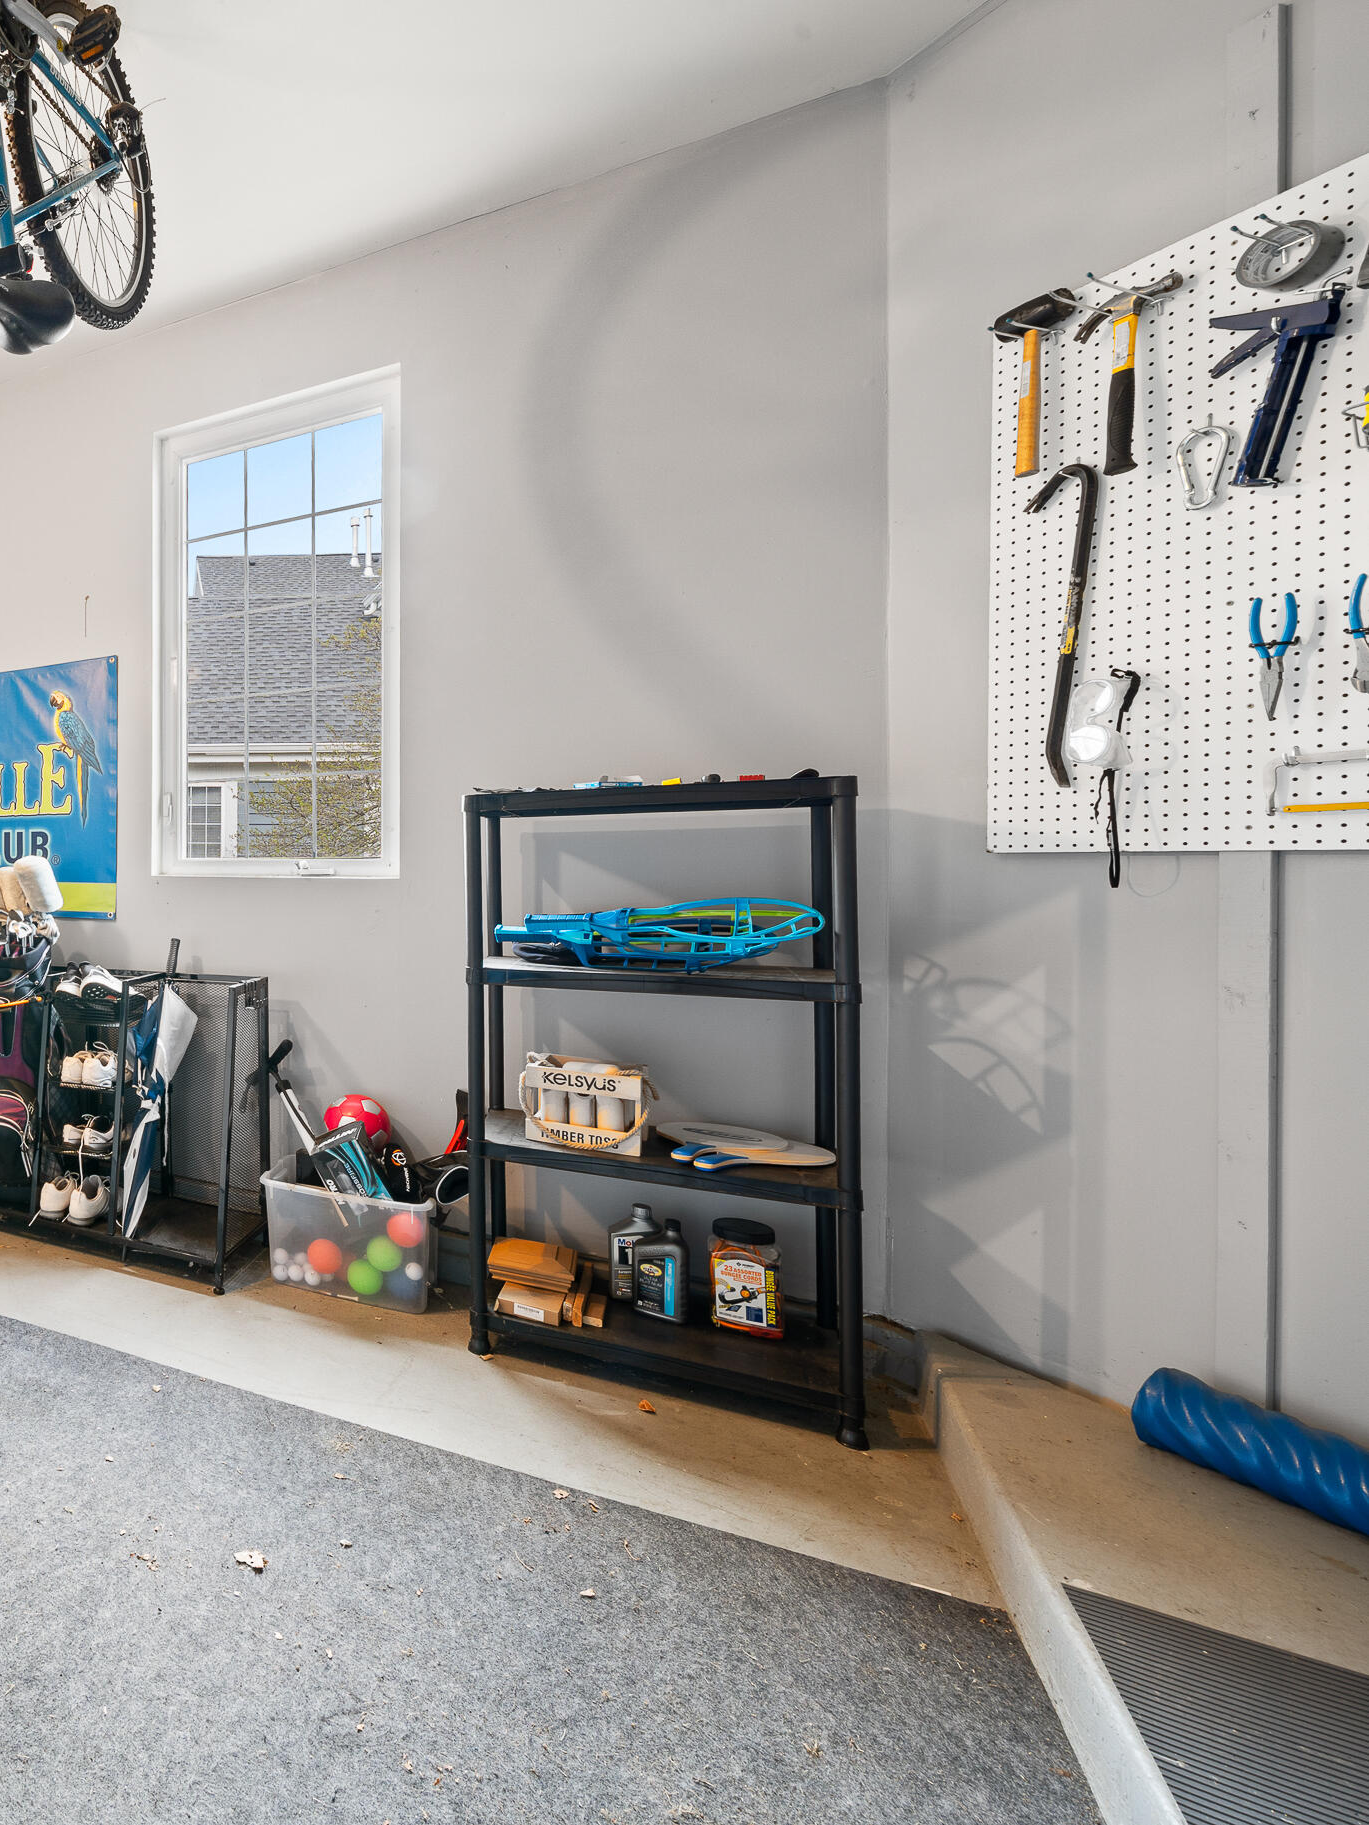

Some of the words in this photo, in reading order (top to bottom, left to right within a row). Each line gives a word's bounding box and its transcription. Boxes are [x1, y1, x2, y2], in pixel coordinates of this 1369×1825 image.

[724, 1264, 733, 1272] 23
[765, 1270, 775, 1292] BUNGEE
[766, 1292, 776, 1310] VALUE
[766, 1309, 776, 1325] PACK
